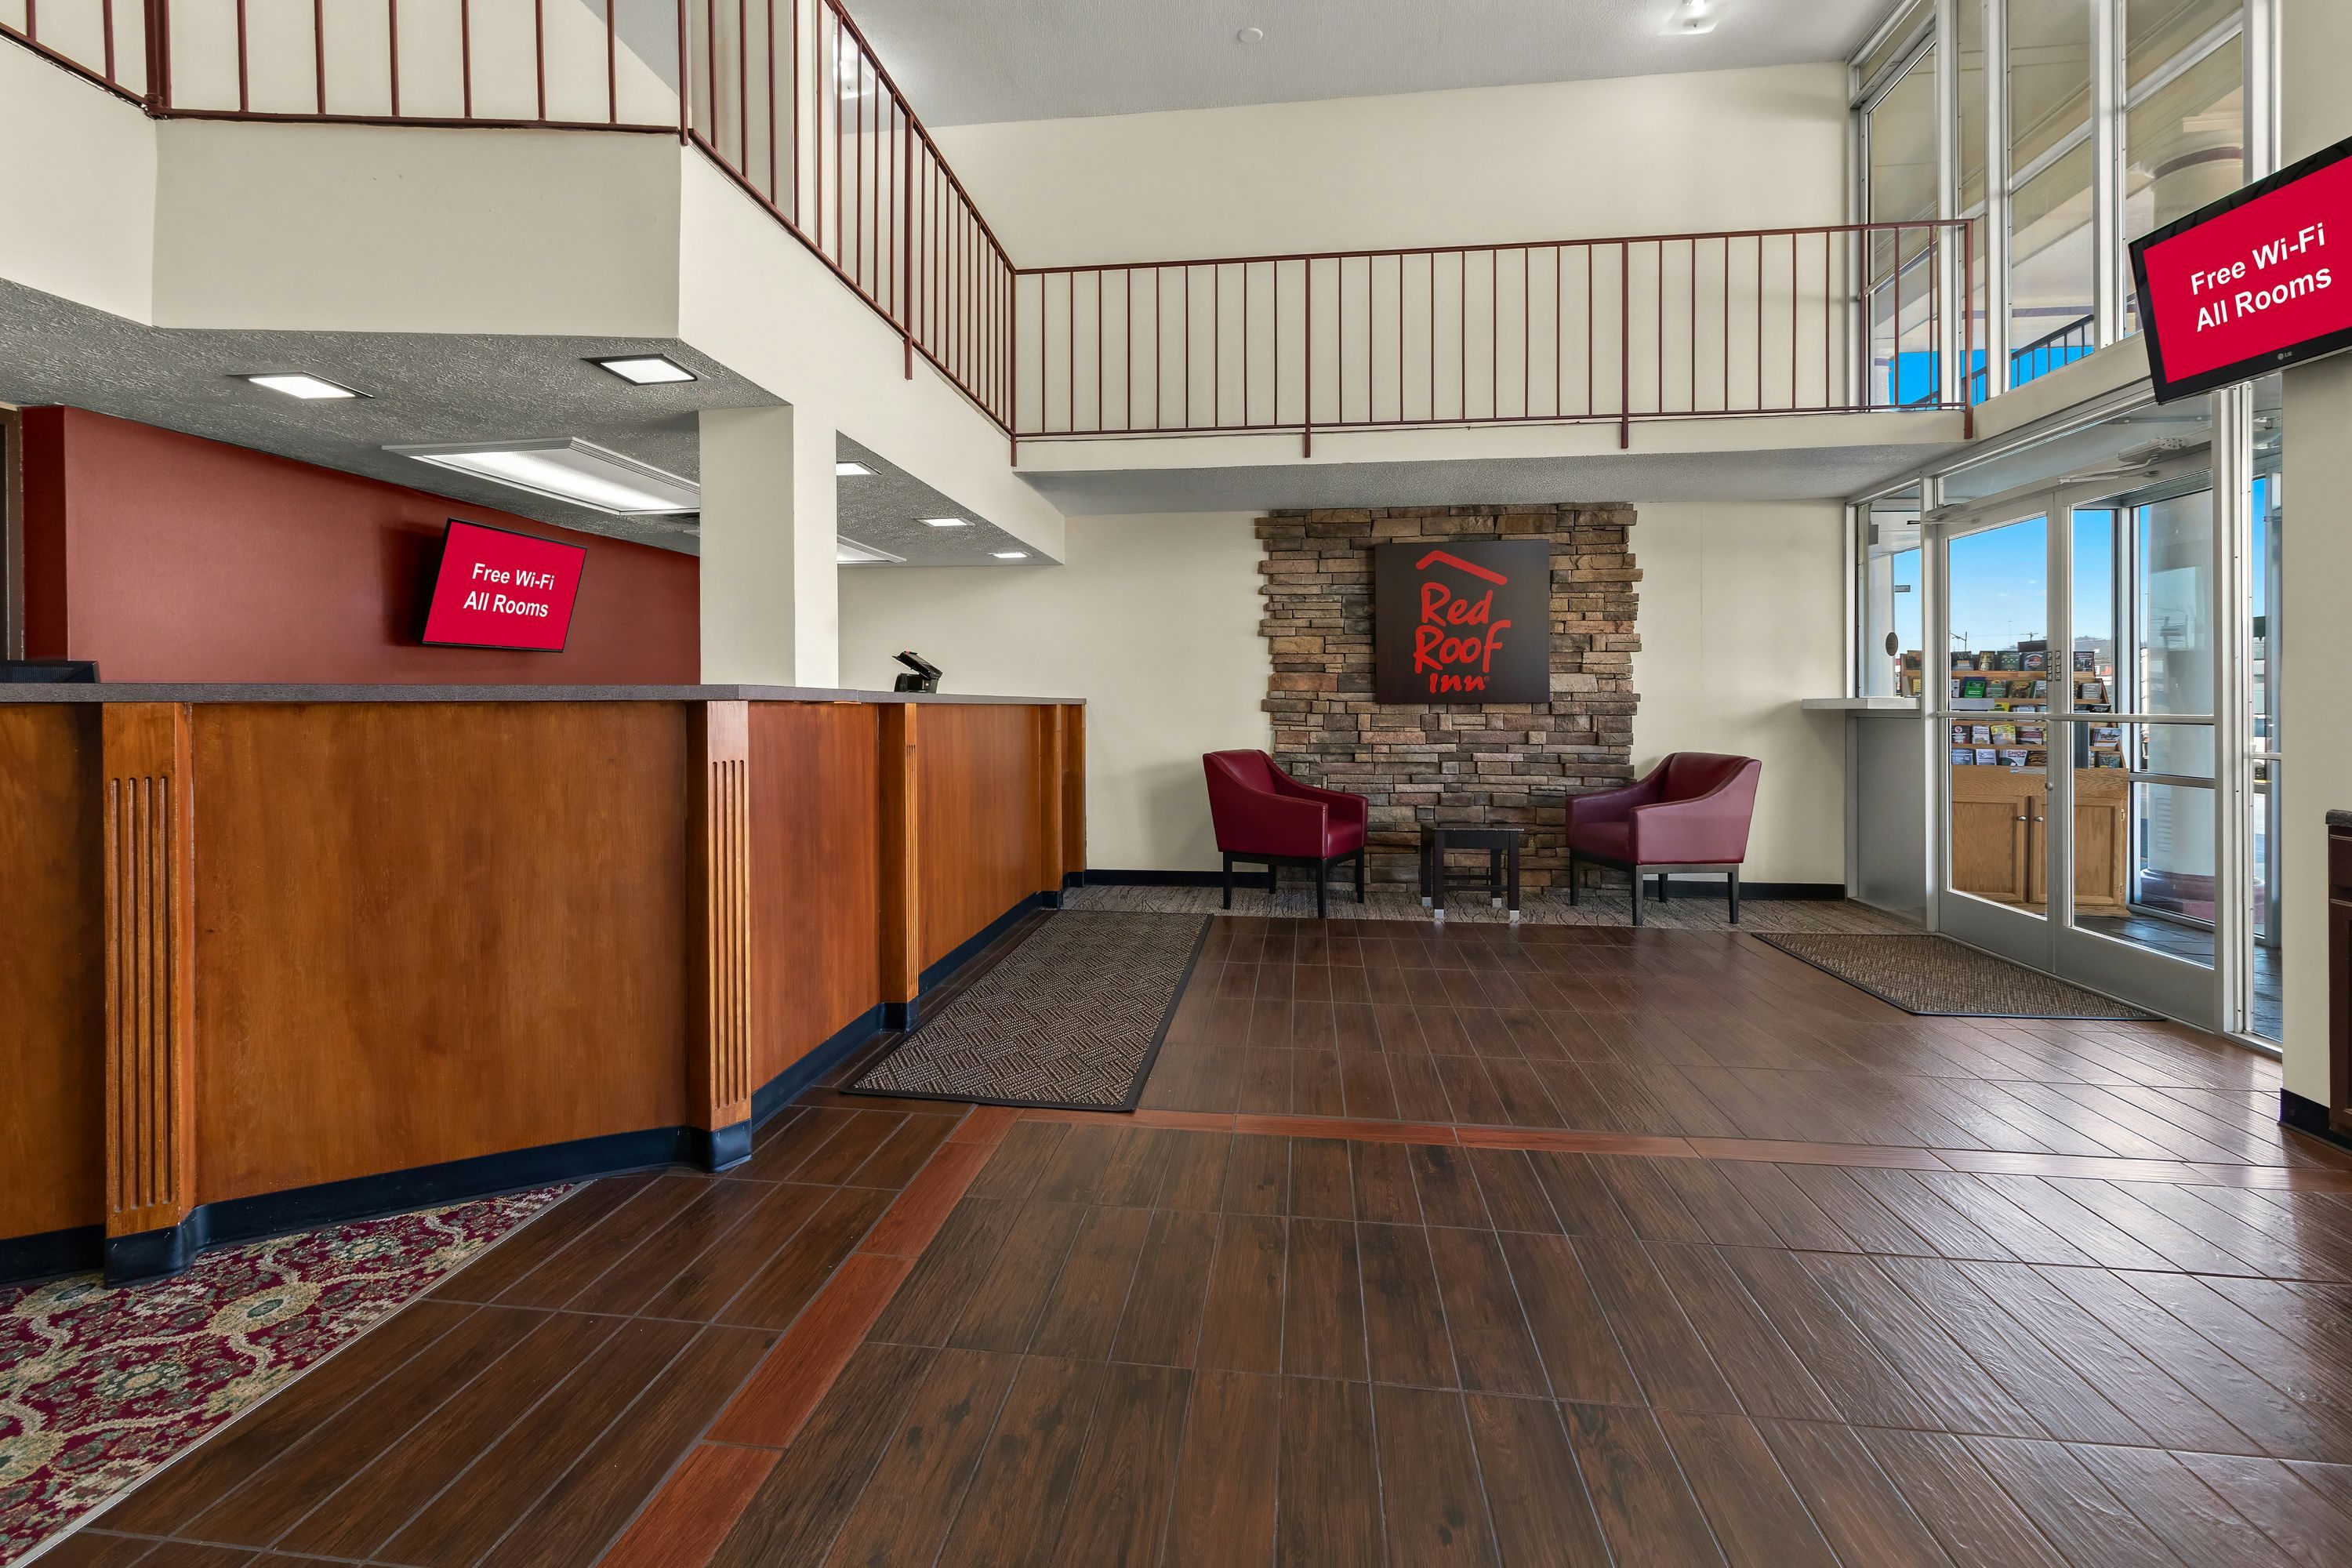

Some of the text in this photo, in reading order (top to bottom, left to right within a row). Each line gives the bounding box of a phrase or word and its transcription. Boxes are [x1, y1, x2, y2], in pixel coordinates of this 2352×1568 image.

[2190, 222, 2325, 296] Free Wi-Fi
[2196, 268, 2332, 332] All Rooms
[472, 562, 555, 590] Free Wi-Fi
[463, 590, 549, 618] All Rooms
[1421, 582, 1494, 626] Red
[1413, 619, 1512, 674] Roof
